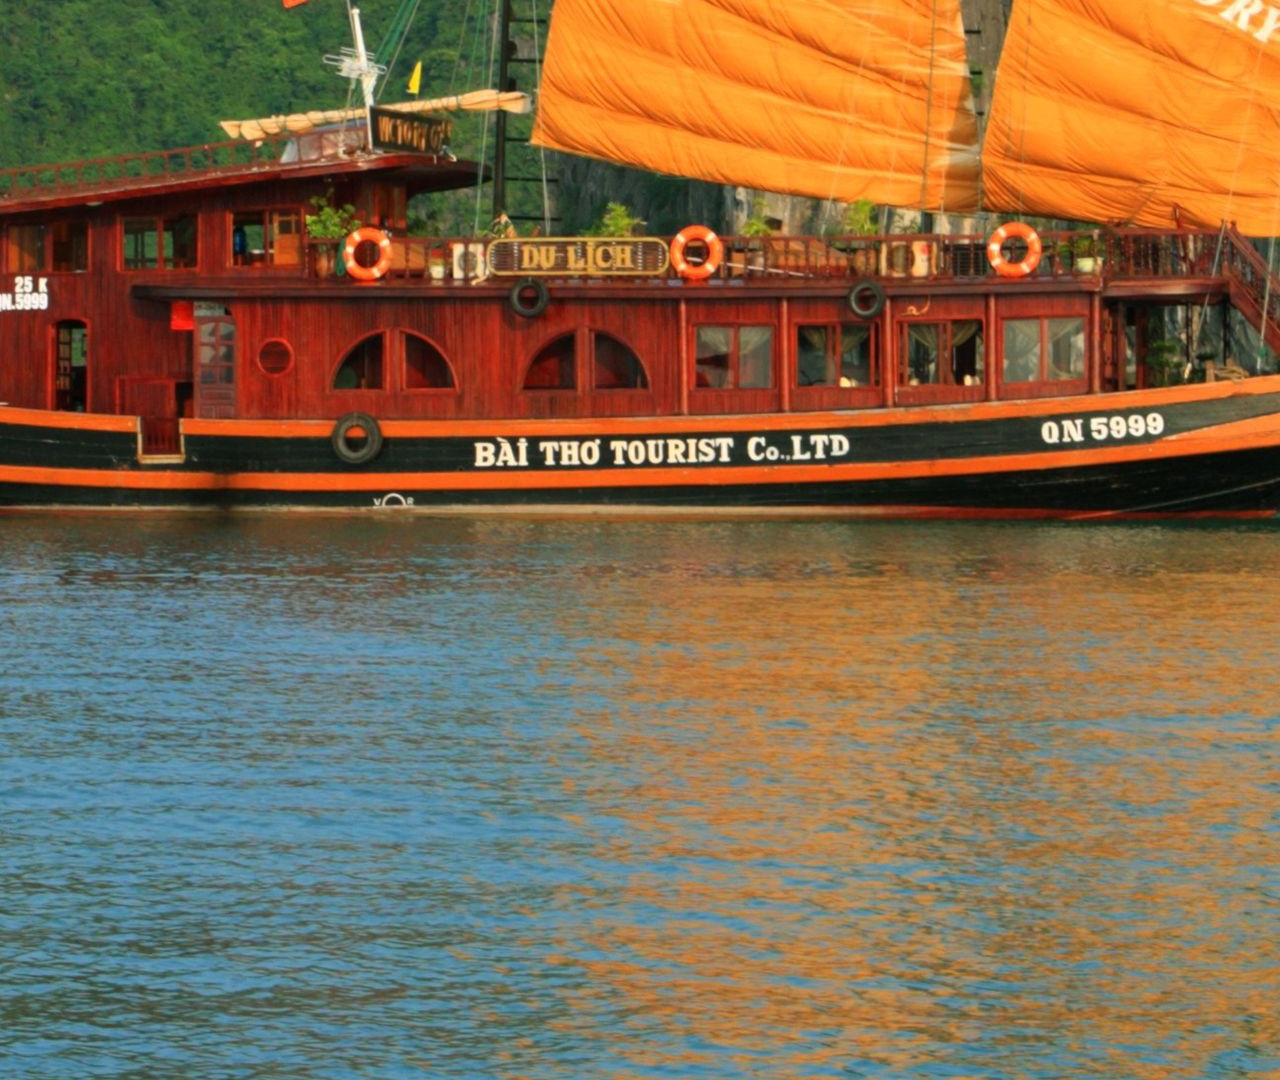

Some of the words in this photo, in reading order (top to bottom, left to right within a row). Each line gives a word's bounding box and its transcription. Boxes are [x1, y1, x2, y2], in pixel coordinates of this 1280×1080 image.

[14, 275, 33, 293] 25
[1041, 419, 1085, 444] QN
[1090, 412, 1165, 440] 5999
[610, 437, 734, 465] TOURIST
